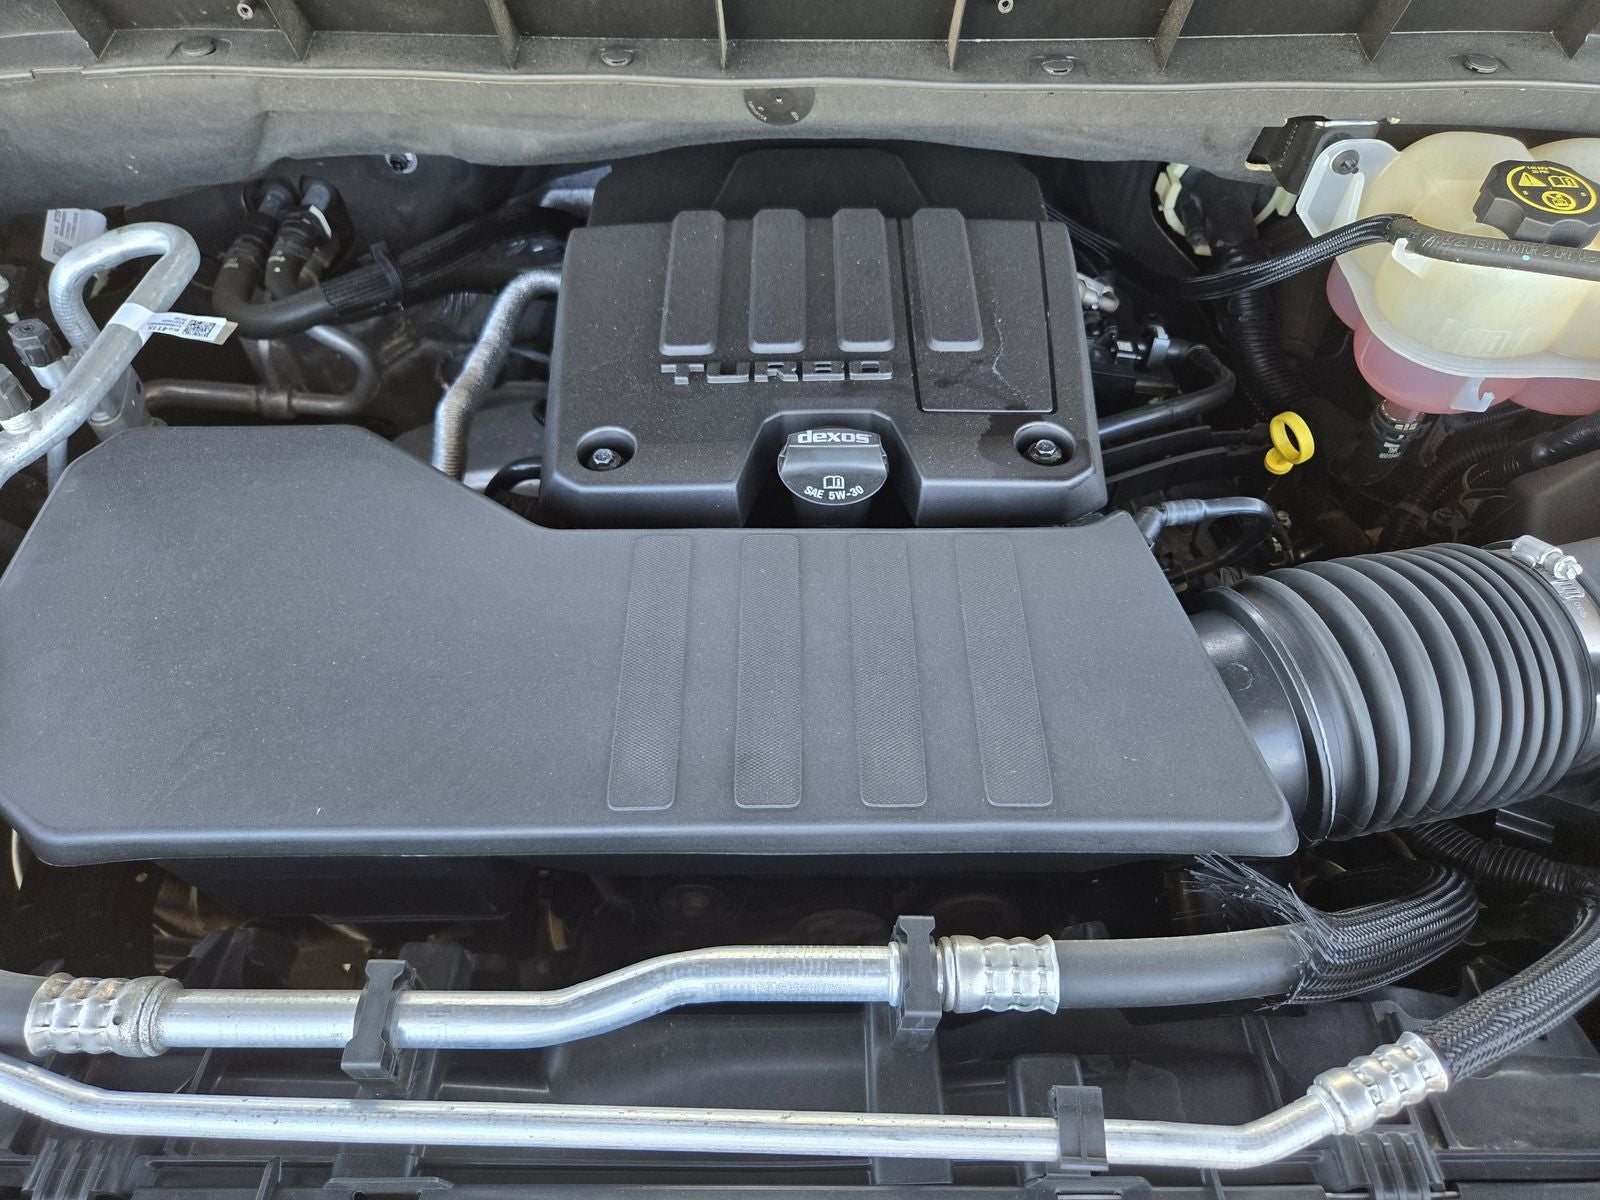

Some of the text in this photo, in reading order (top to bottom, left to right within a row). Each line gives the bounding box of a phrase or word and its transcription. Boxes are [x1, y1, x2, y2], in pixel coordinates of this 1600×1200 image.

[661, 360, 893, 385] TURBO
[797, 430, 871, 444] dexos
[804, 485, 864, 500] SAE 5W-30
